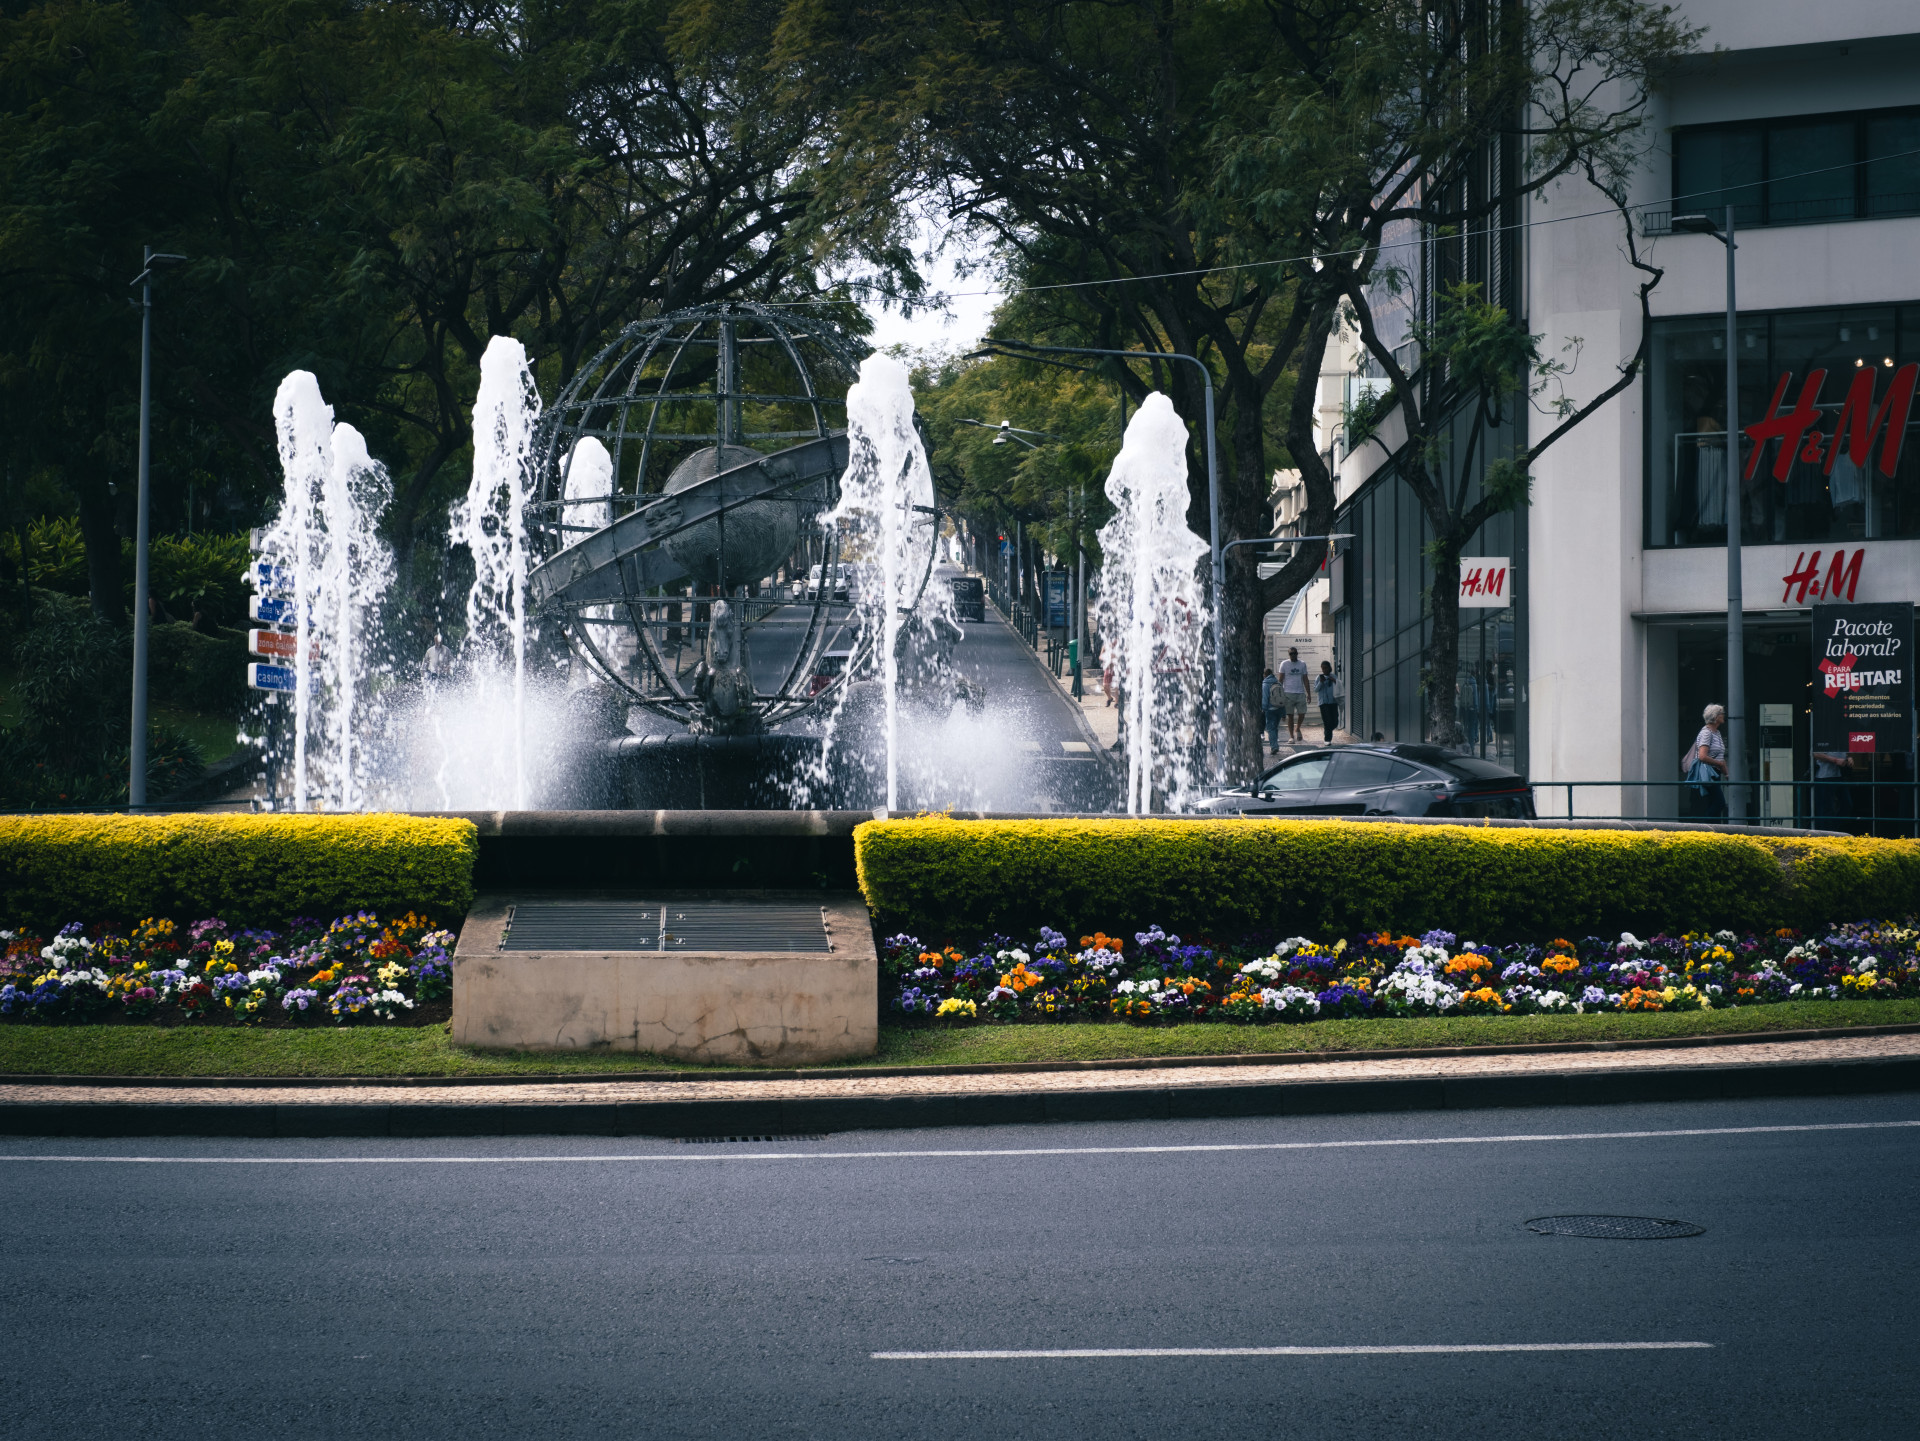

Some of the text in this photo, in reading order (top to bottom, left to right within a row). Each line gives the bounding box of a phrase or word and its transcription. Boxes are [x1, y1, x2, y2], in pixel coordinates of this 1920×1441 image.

[1744, 363, 1919, 483] H&M
[1461, 567, 1506, 597] H&M
[1782, 548, 1865, 605] H&M
[1832, 618, 1893, 636] Pacote
[258, 640, 273, 649] zona
[1825, 637, 1901, 657] laboral?
[257, 671, 283, 684] casino
[1828, 665, 1832, 673] É
[1824, 669, 1902, 691] REJEITAR!
